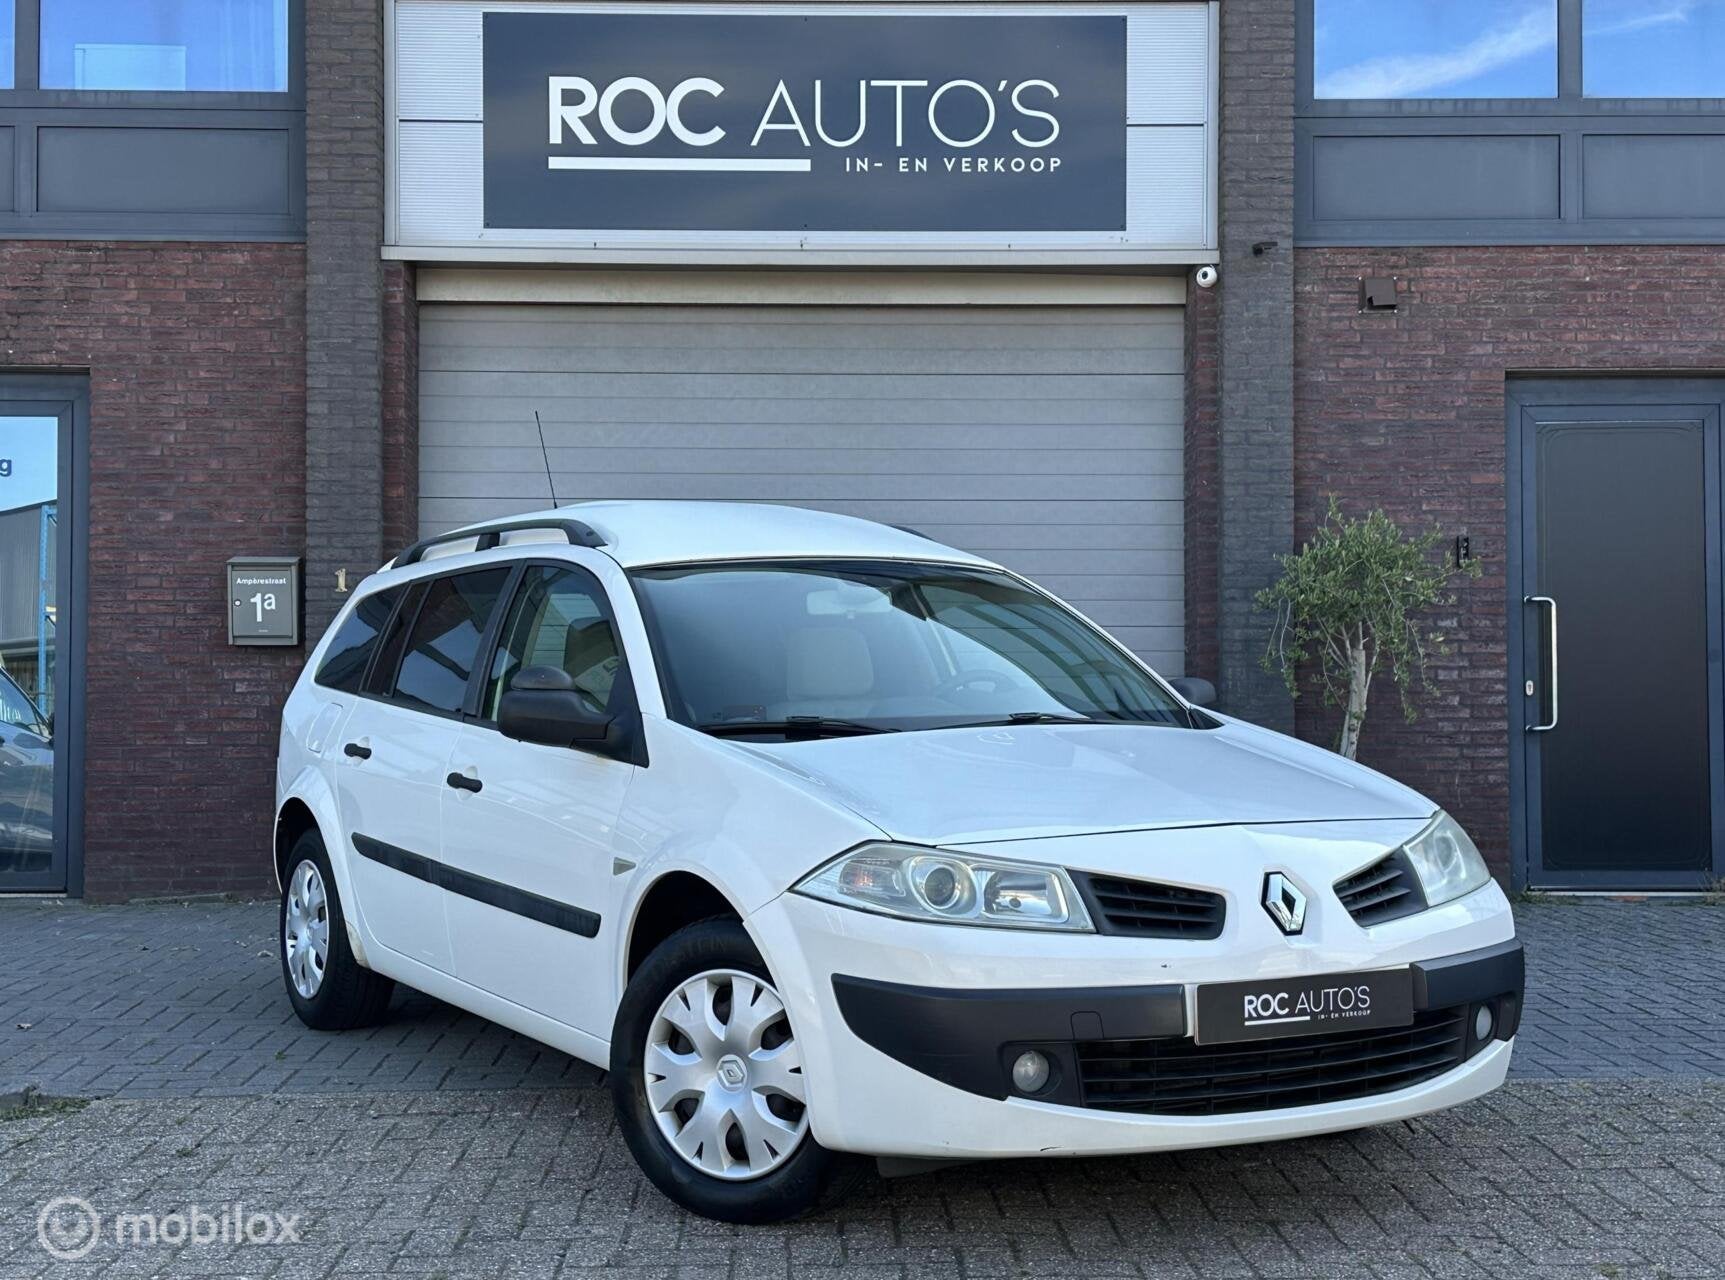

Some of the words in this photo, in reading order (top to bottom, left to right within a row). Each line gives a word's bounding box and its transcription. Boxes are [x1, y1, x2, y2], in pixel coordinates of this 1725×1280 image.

[548, 76, 726, 147] ROC
[750, 78, 1060, 148] AUTO'S
[845, 156, 884, 172] IN-
[899, 157, 928, 172] EN
[944, 157, 1062, 173] VERKOOP
[334, 568, 348, 592] 1
[250, 592, 276, 622] 1a
[1244, 992, 1289, 1018] ROC
[1295, 985, 1370, 1014] AUTO'S
